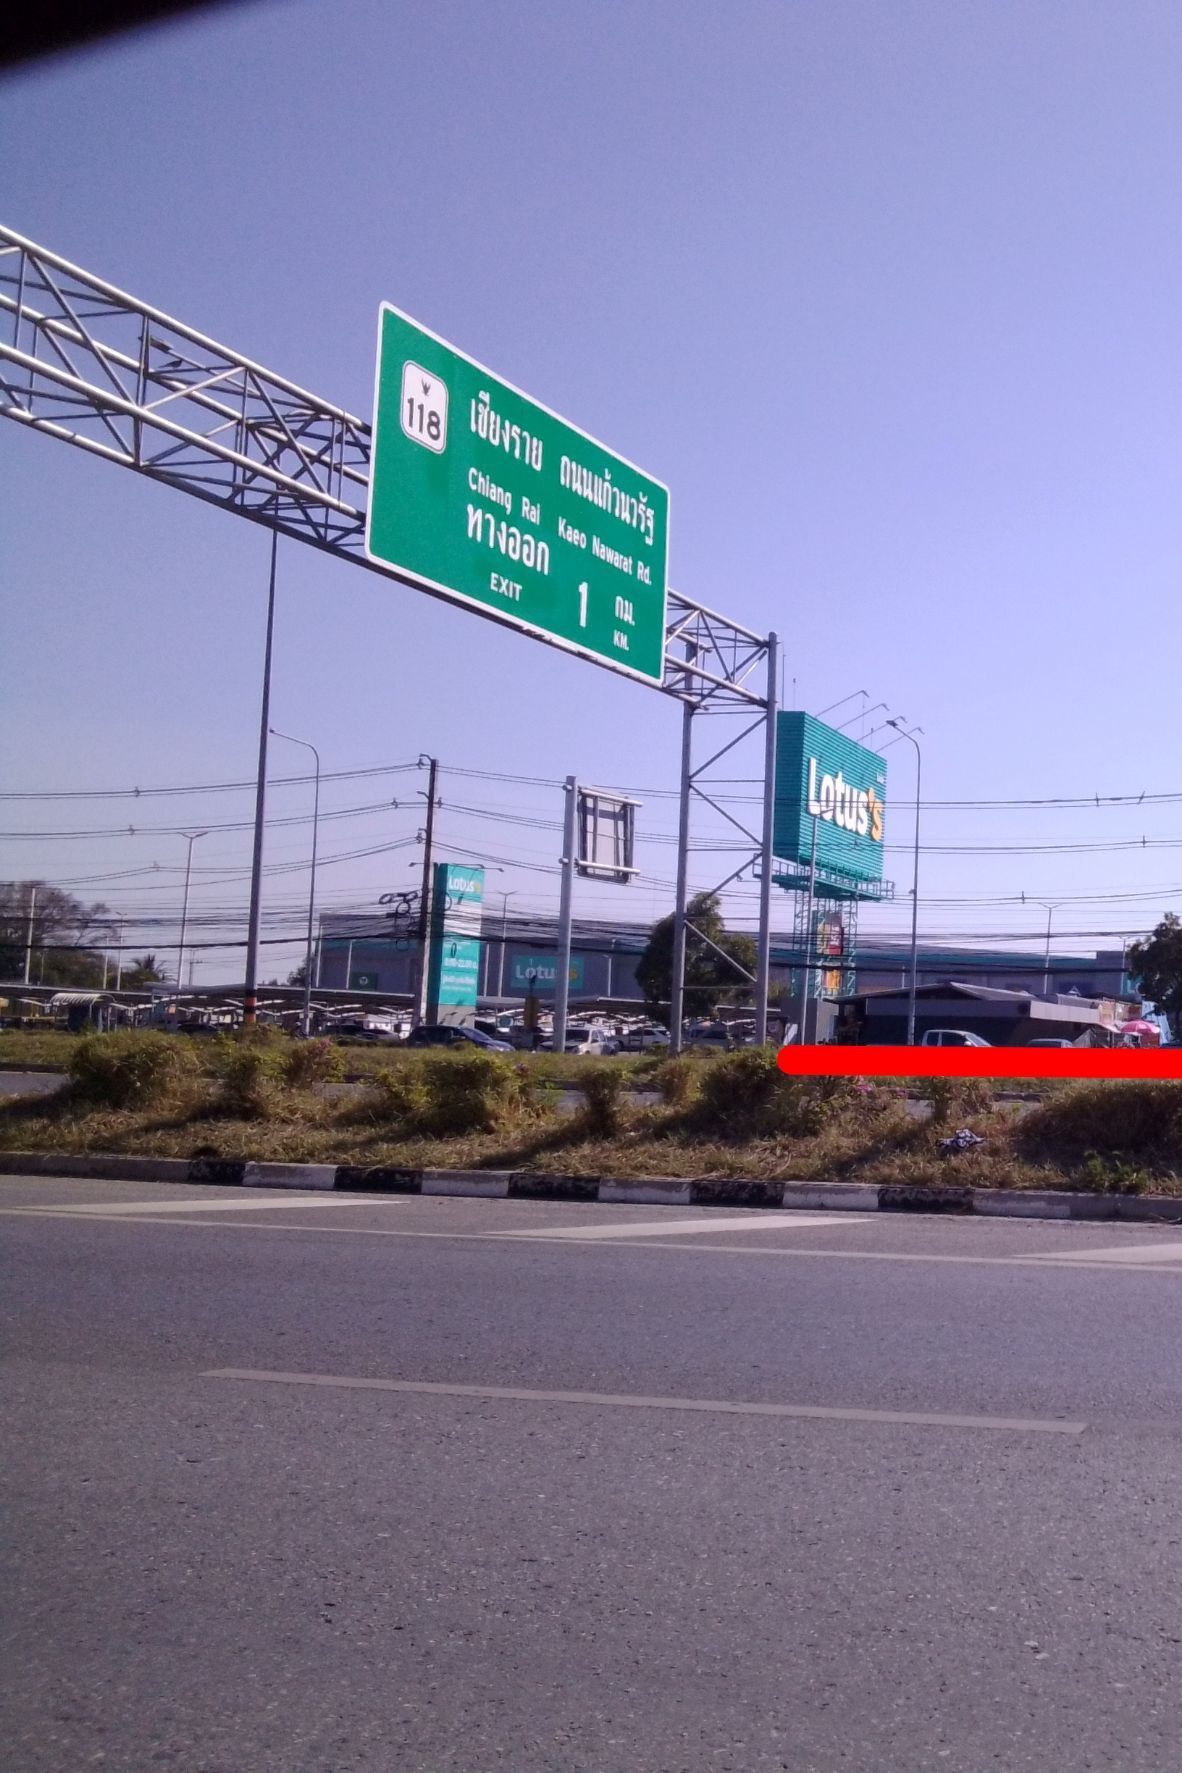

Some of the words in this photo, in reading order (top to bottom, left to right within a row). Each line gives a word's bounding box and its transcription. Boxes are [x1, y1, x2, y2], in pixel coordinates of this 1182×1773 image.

[407, 397, 441, 442] 118
[470, 390, 543, 472] เชียงราย
[560, 455, 654, 546] ถนนแก้วนวรัฐ
[467, 503, 550, 576] ทางออก
[468, 467, 512, 516] Chiang
[522, 496, 540, 526] Rai
[558, 516, 587, 549] Kaeo
[592, 535, 633, 576] Nawarat
[637, 560, 652, 585] Rd.
[490, 572, 522, 602] EXIT
[578, 581, 588, 628] 1
[615, 595, 635, 627] กม.
[613, 629, 629, 651] KM.
[808, 756, 884, 842] Lotus's
[449, 876, 481, 892] Lotus
[516, 965, 578, 980] Lotu
